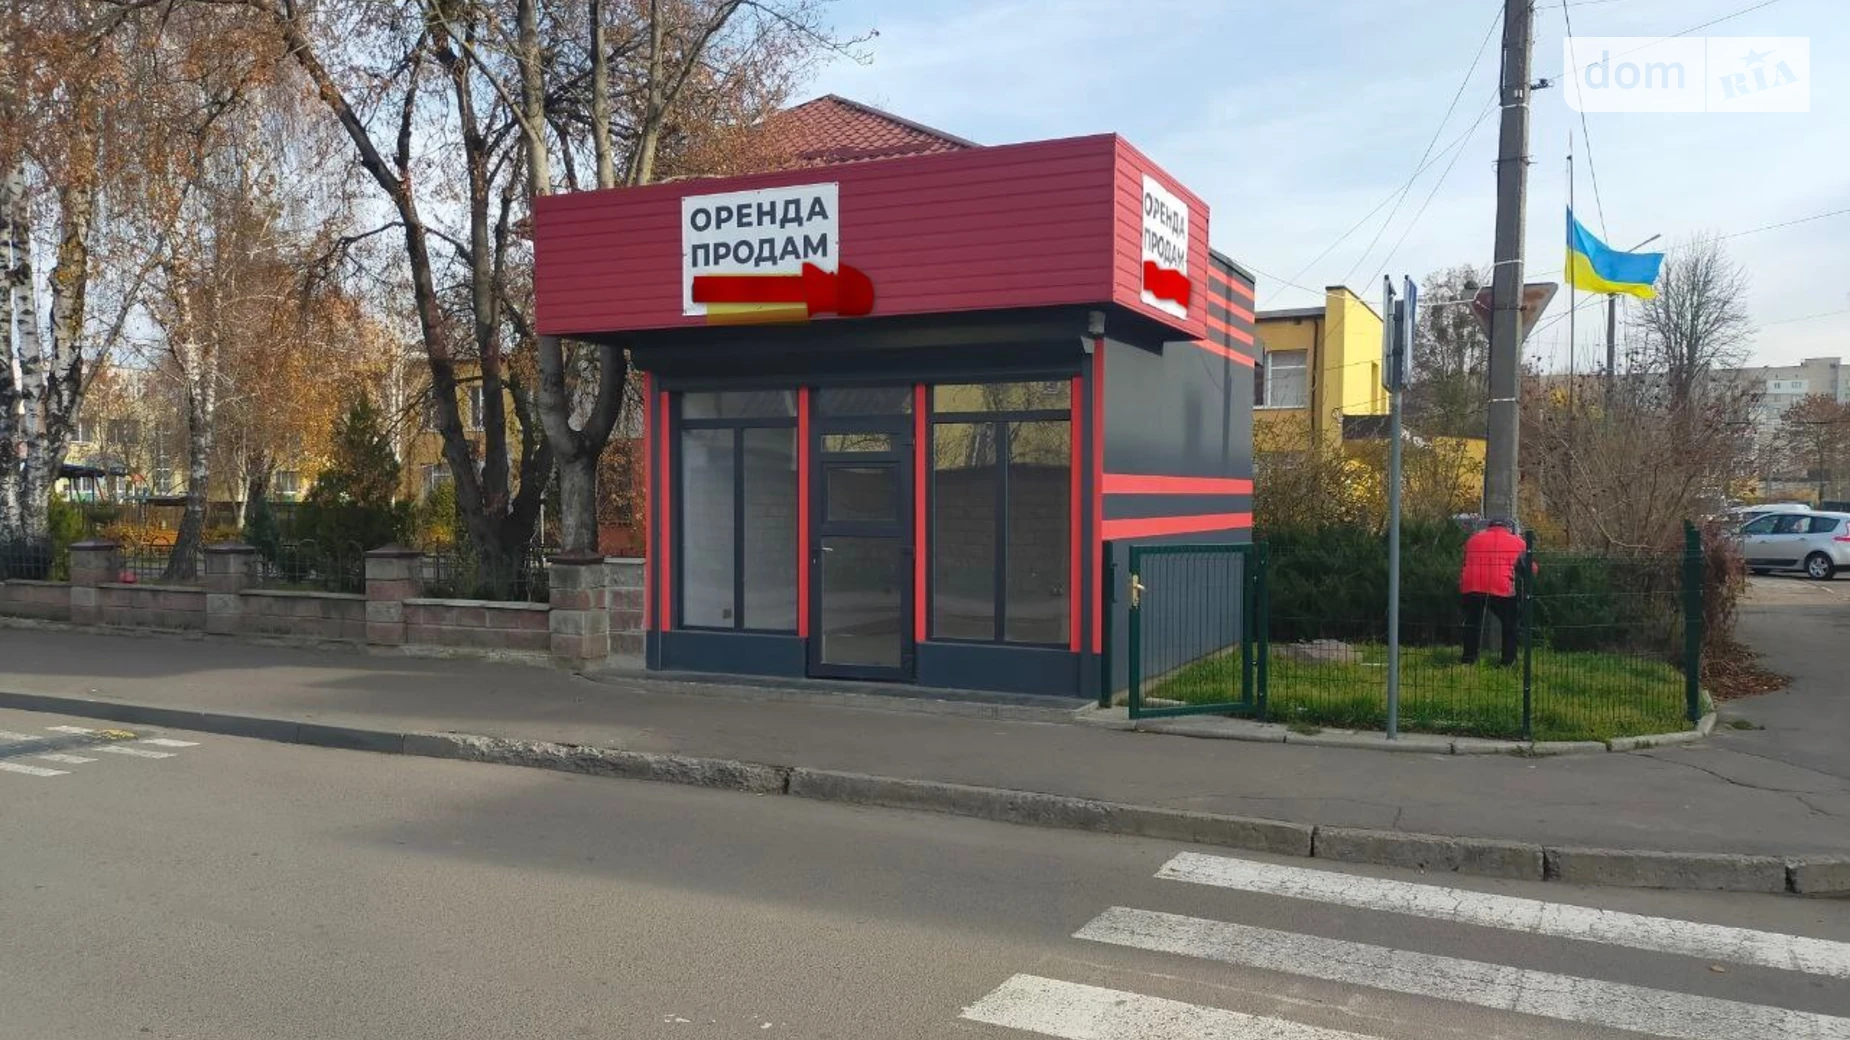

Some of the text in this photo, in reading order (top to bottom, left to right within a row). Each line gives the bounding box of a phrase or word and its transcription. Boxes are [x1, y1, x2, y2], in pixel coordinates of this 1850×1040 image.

[690, 196, 828, 232] ОРЕНДА
[1144, 192, 1185, 239] ОРЕНДА
[691, 233, 828, 268] ПРОДАМ
[1144, 227, 1185, 269] ПРОДАМ
